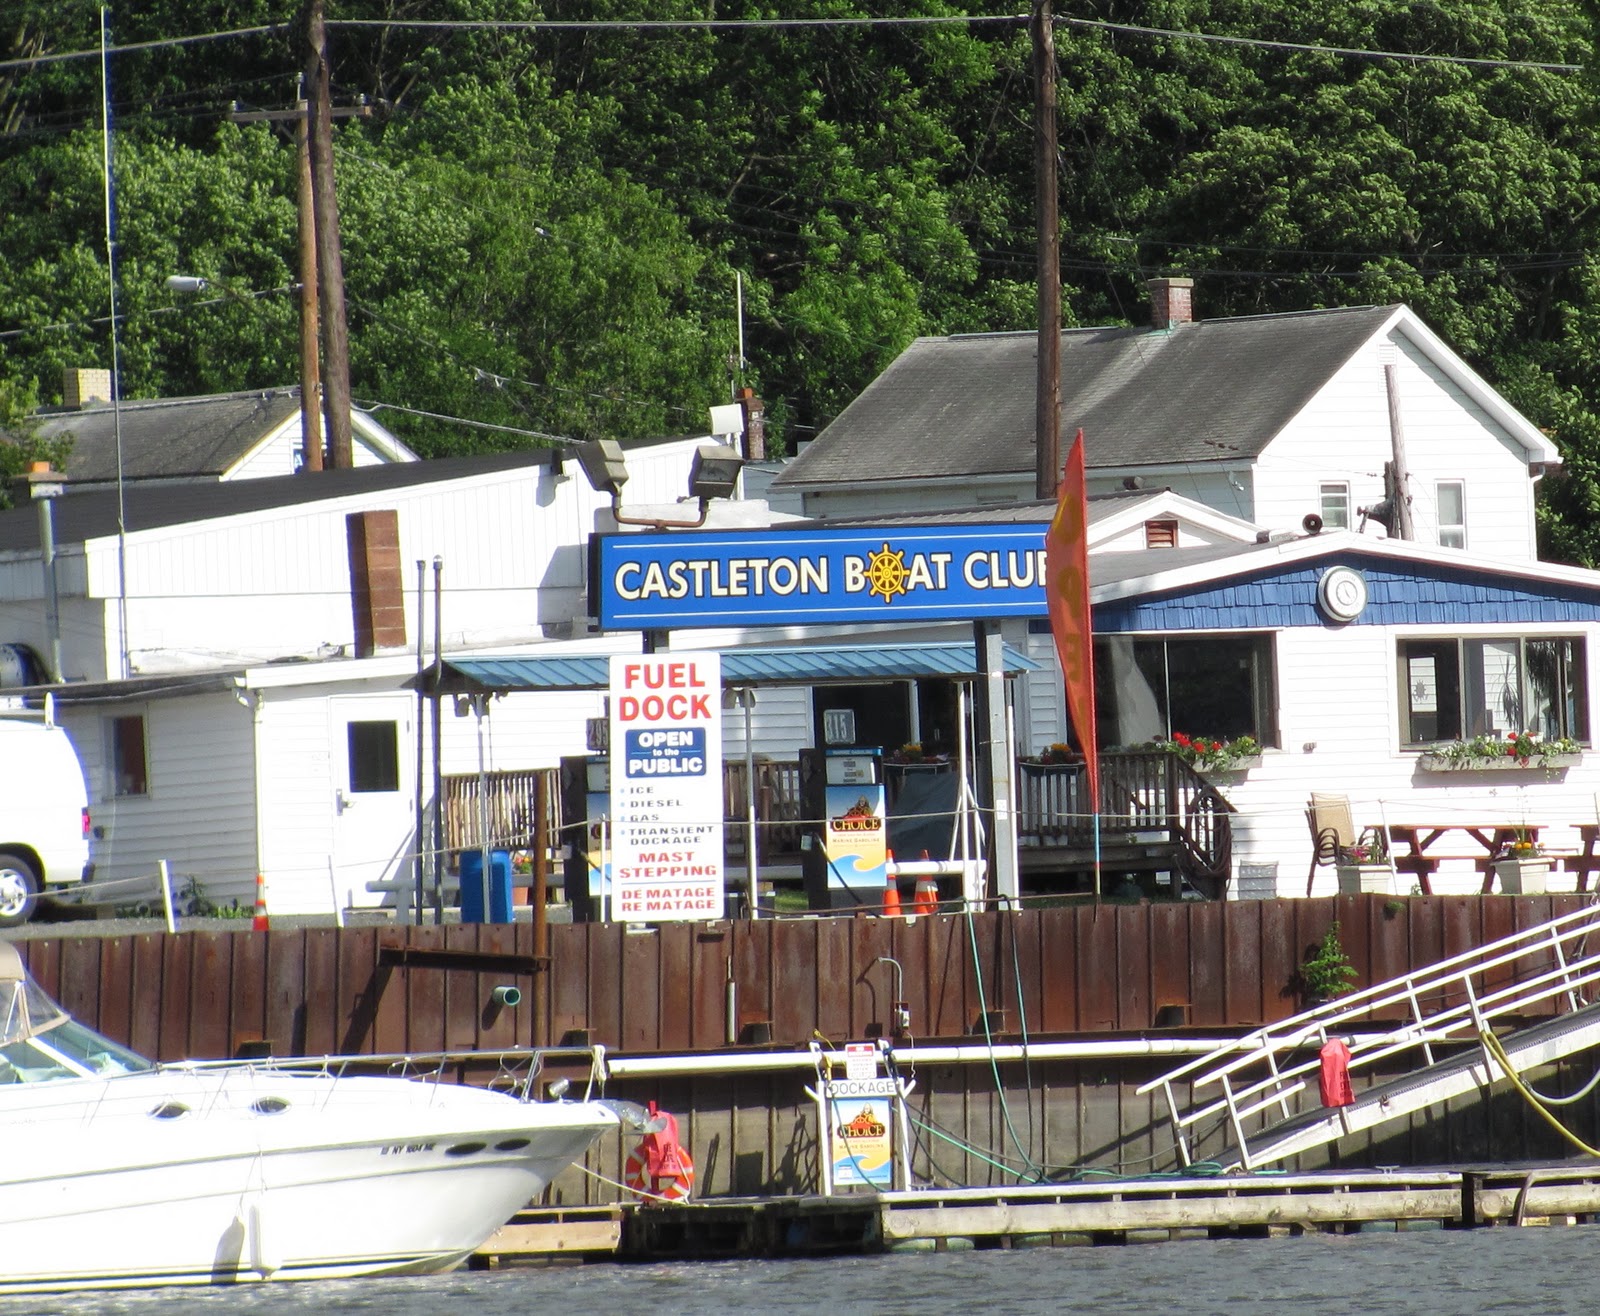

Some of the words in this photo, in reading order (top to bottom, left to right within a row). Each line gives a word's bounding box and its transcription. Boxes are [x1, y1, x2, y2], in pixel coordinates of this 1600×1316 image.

[614, 556, 829, 600] CASTLETON
[625, 662, 706, 689] FUEL
[619, 694, 712, 721] DOCK
[638, 731, 693, 748] OPEN
[652, 748, 663, 756] to
[664, 748, 680, 756] the
[629, 757, 703, 775] PUBLIC
[630, 786, 654, 794] ICE
[630, 799, 683, 808] DIESEL
[630, 814, 659, 822] GAS
[832, 818, 880, 831] CHOICE
[629, 826, 714, 836] TRANSIENT
[630, 836, 702, 846] DOCKAGE
[638, 851, 695, 863] MAST
[619, 865, 717, 878] STEPPING
[646, 887, 715, 899] MATAGE
[646, 899, 716, 911] MATAGE
[831, 1081, 895, 1096] DOCKAGE
[840, 1124, 883, 1137] CHOICE
